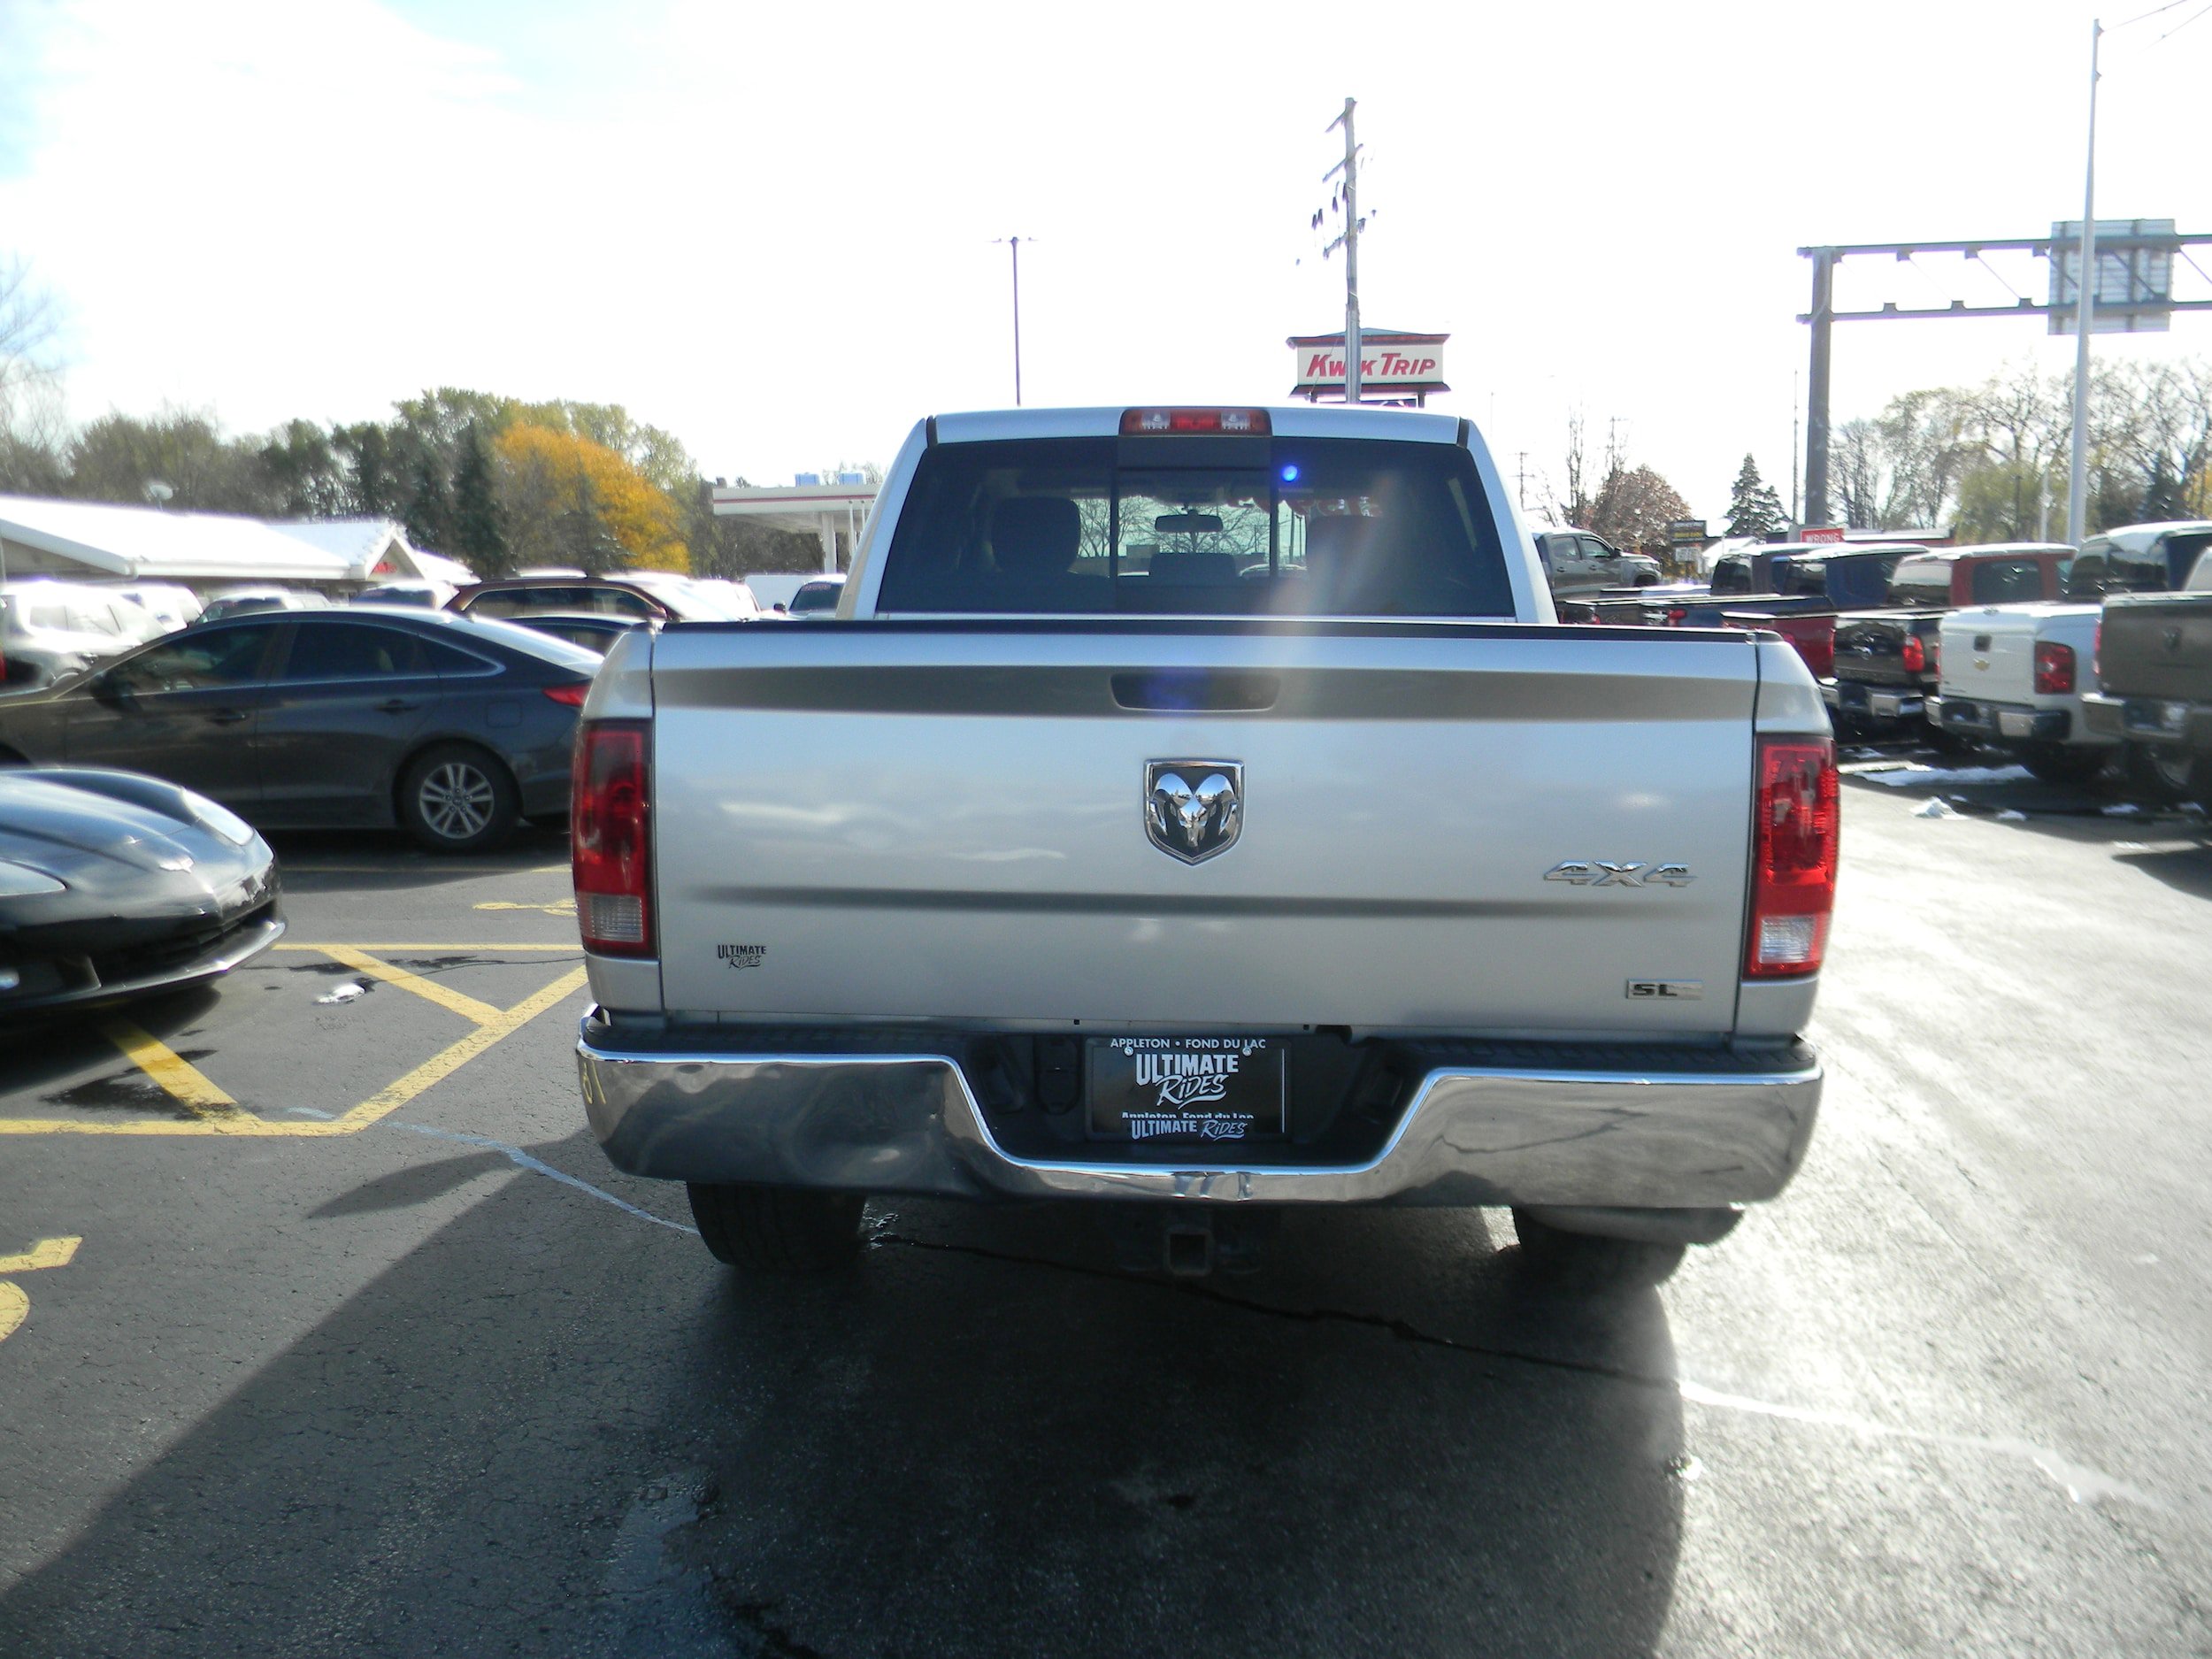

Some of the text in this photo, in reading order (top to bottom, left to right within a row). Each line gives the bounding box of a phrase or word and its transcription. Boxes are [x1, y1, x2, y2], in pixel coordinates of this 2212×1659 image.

[1306, 352, 1436, 377] KWK TRIP
[718, 944, 766, 959] ULTIMATE
[1110, 1038, 1266, 1049] APPLETON FOND DU LAC
[1136, 1054, 1239, 1086] ULTIMATE
[1131, 1119, 1198, 1140] ULTIMATE
